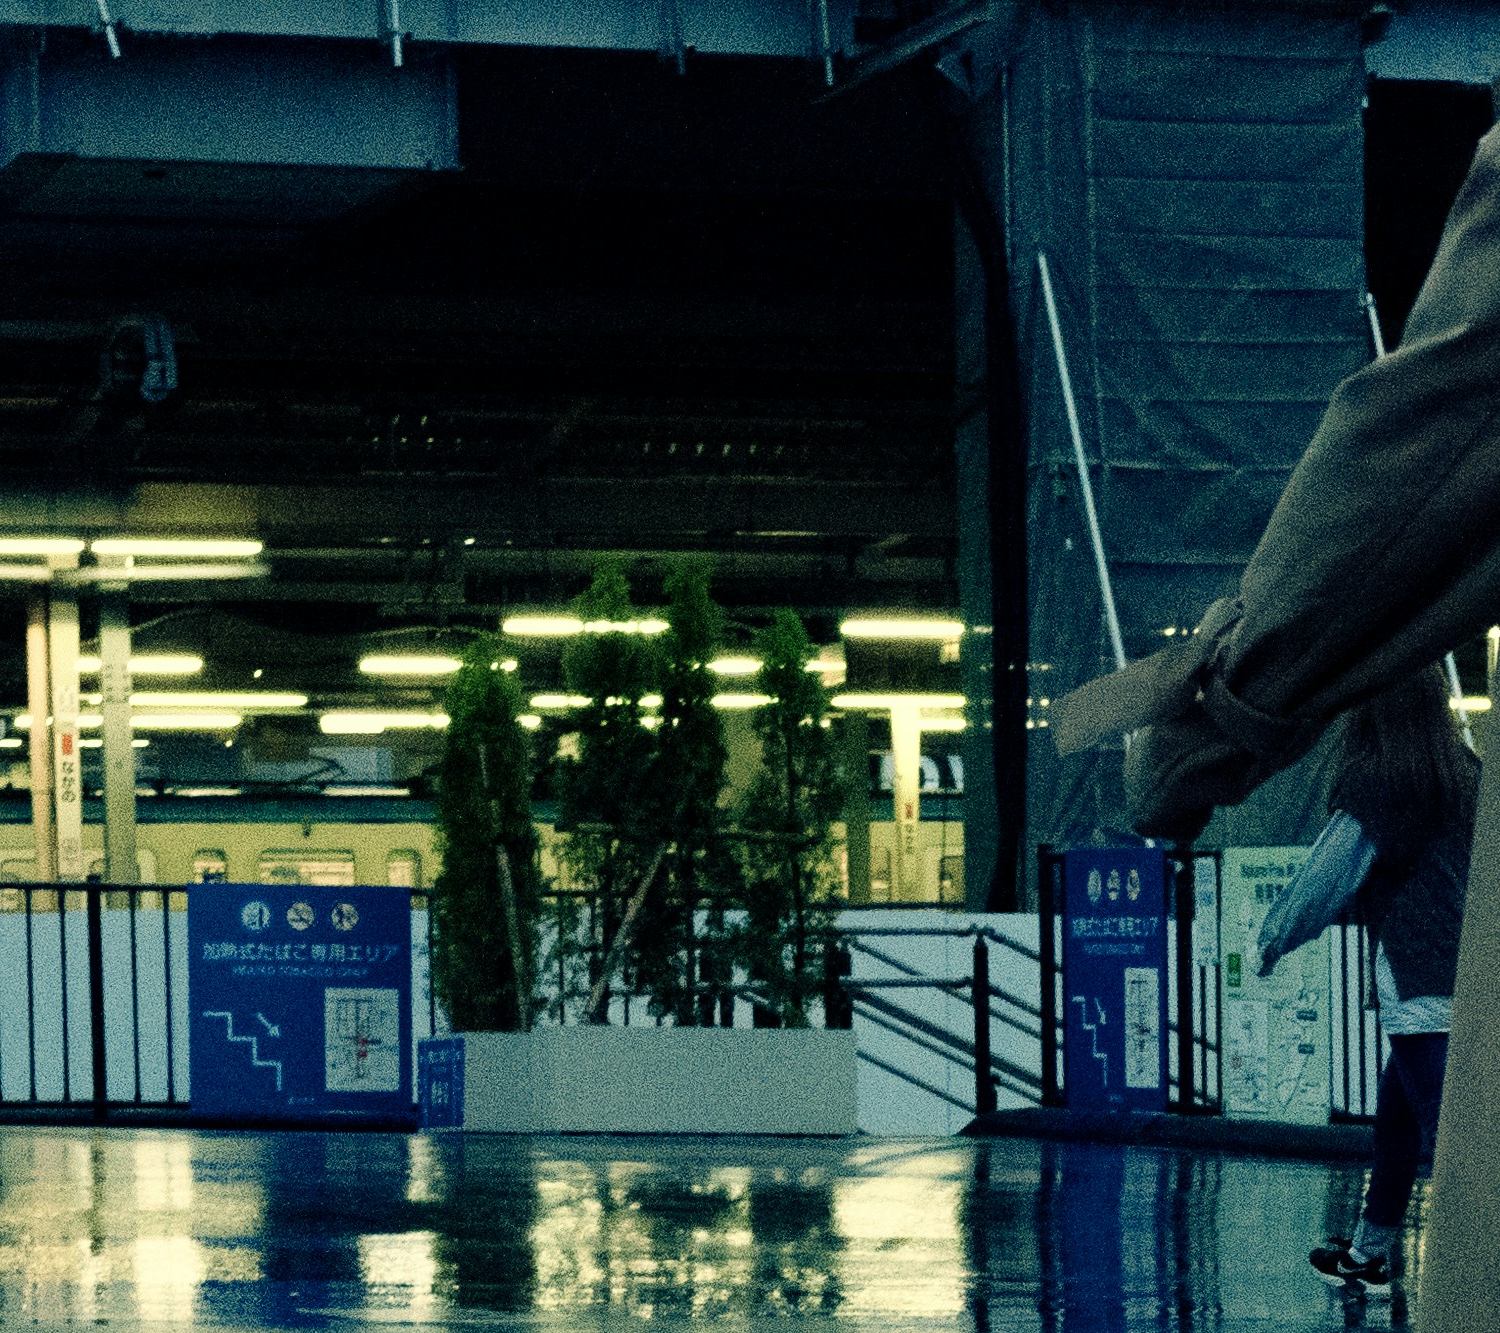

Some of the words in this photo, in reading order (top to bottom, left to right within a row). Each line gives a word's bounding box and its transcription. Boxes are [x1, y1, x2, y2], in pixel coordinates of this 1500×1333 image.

[62, 761, 76, 804] なかの
[201, 942, 399, 964] 加熱式たばこ専用エリア
